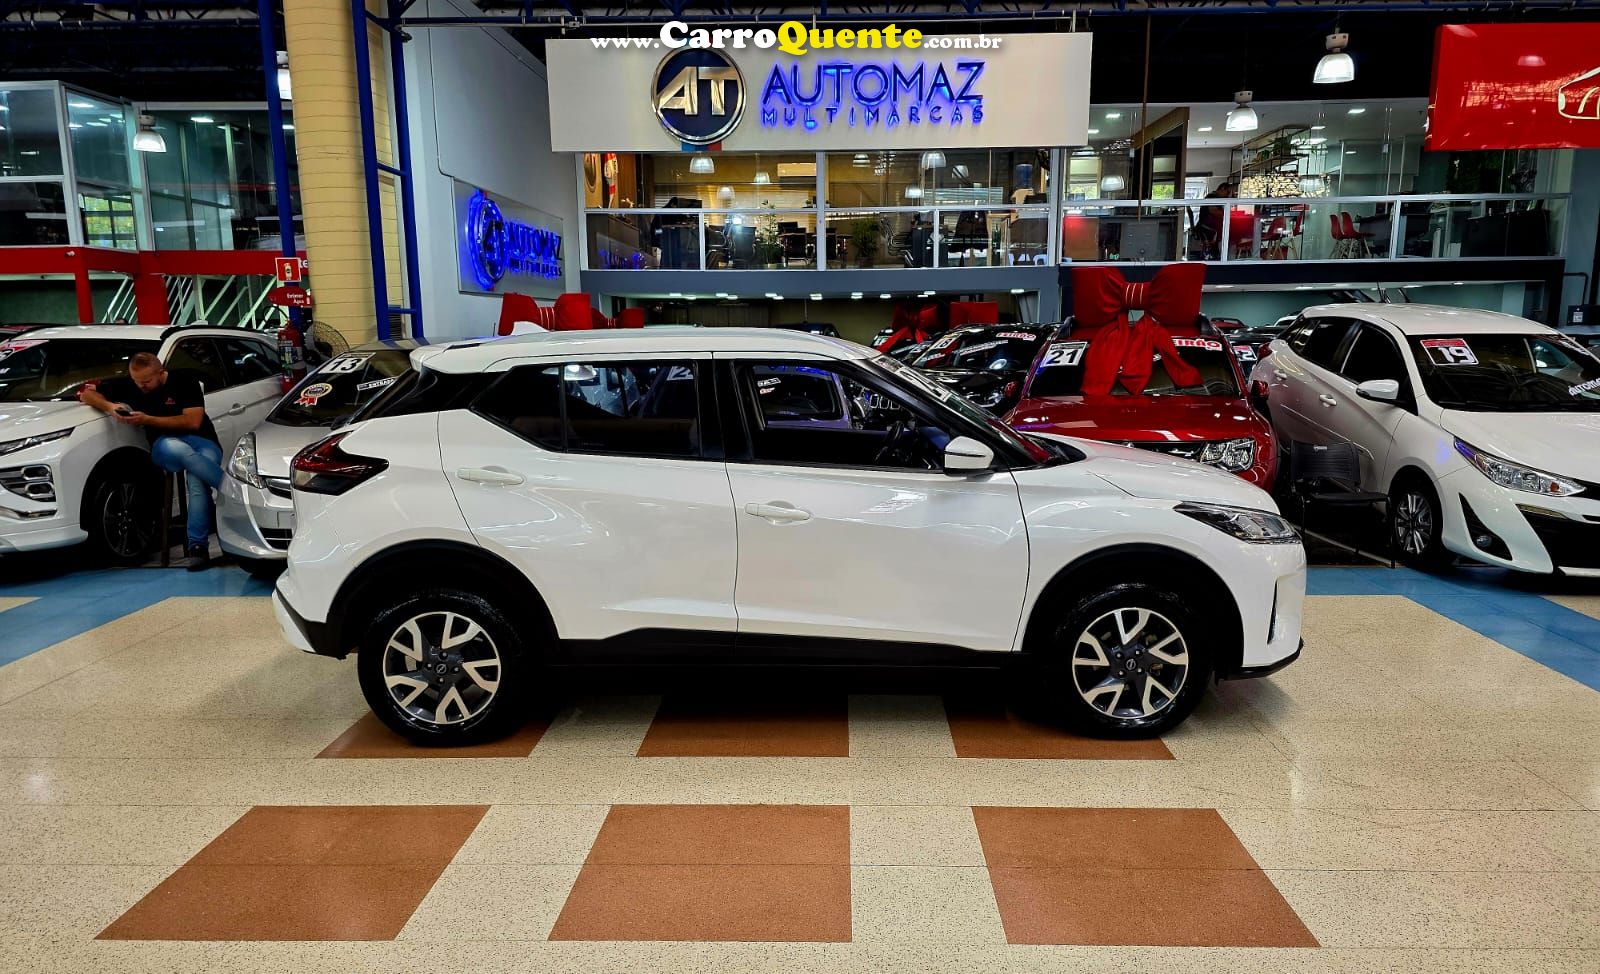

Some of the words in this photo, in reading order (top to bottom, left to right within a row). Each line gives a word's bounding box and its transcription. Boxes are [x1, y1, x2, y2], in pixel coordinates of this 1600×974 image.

[762, 61, 986, 105] AUTOMAZ
[761, 105, 985, 127] MULTIMARCAS
[1173, 338, 1222, 349] EIRÃO
[1050, 350, 1077, 364] 21
[1437, 346, 1476, 363] 19
[330, 359, 362, 371] 13
